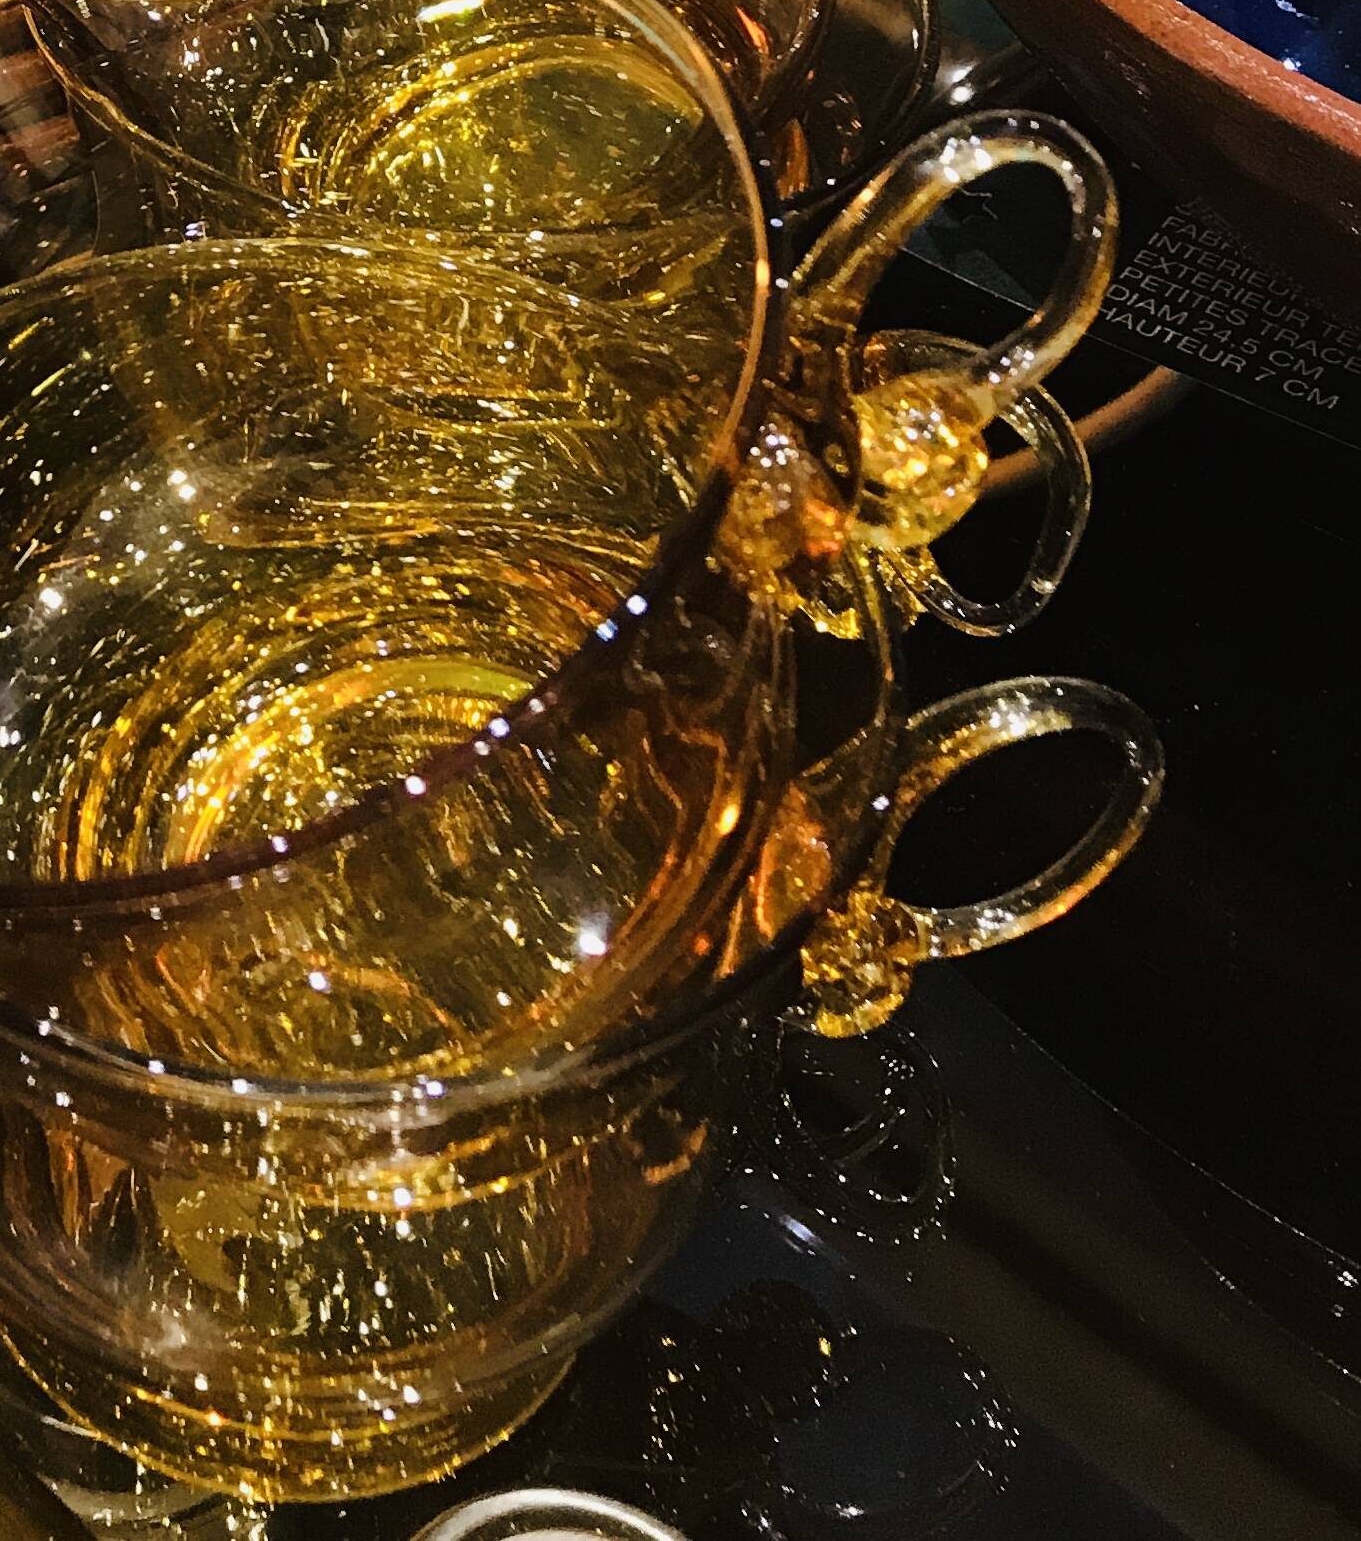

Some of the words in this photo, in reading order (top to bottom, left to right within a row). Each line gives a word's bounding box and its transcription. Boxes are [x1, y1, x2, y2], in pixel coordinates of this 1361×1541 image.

[1118, 266, 1247, 327] PETITES
[1133, 249, 1310, 328] EXTERIEUR
[1147, 231, 1305, 301] INTERIEU
[1098, 306, 1248, 374] HAUTEUR
[1254, 366, 1277, 382] 7
[1282, 378, 1340, 410] CM
[1105, 284, 1189, 326] DIAM
[1191, 319, 1260, 356] 24.5
[1268, 349, 1325, 380] CM
